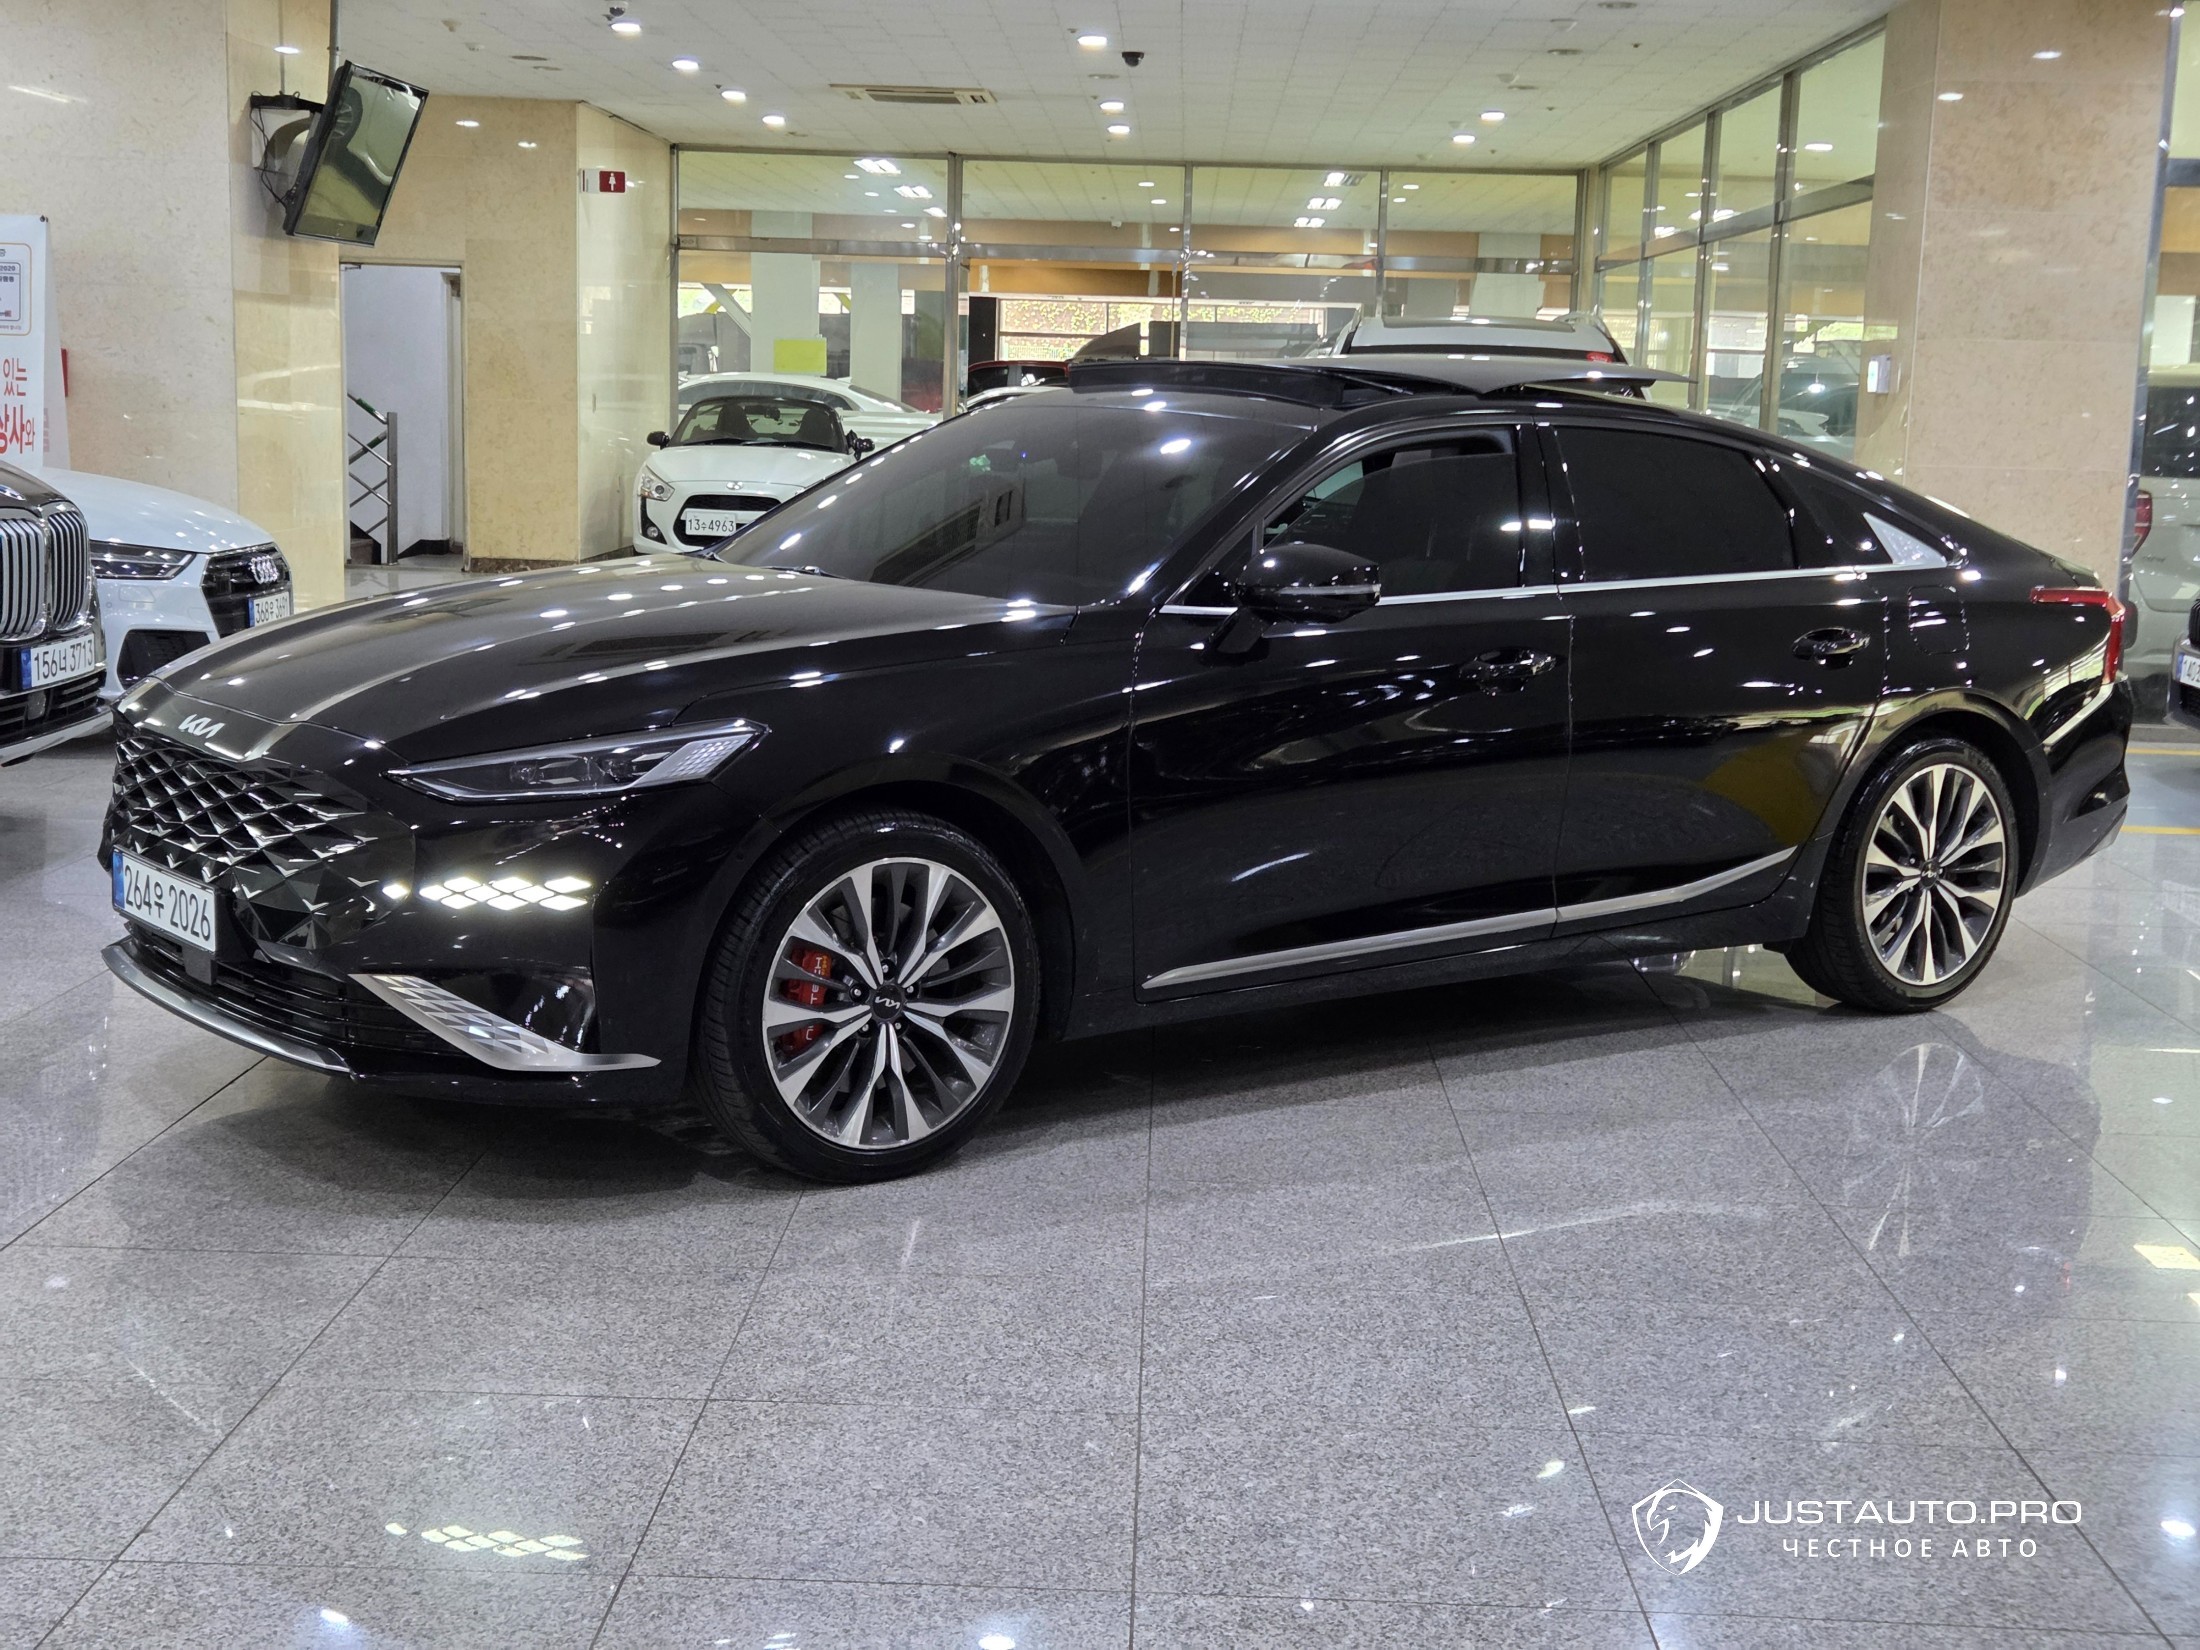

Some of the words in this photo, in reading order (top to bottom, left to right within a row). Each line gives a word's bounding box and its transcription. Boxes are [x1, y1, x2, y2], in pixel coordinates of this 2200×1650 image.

[2, 357, 28, 397] 있는
[33, 647, 68, 681] 156너
[69, 638, 93, 672] 3713
[124, 864, 165, 919] 264우
[168, 884, 211, 942] 2026
